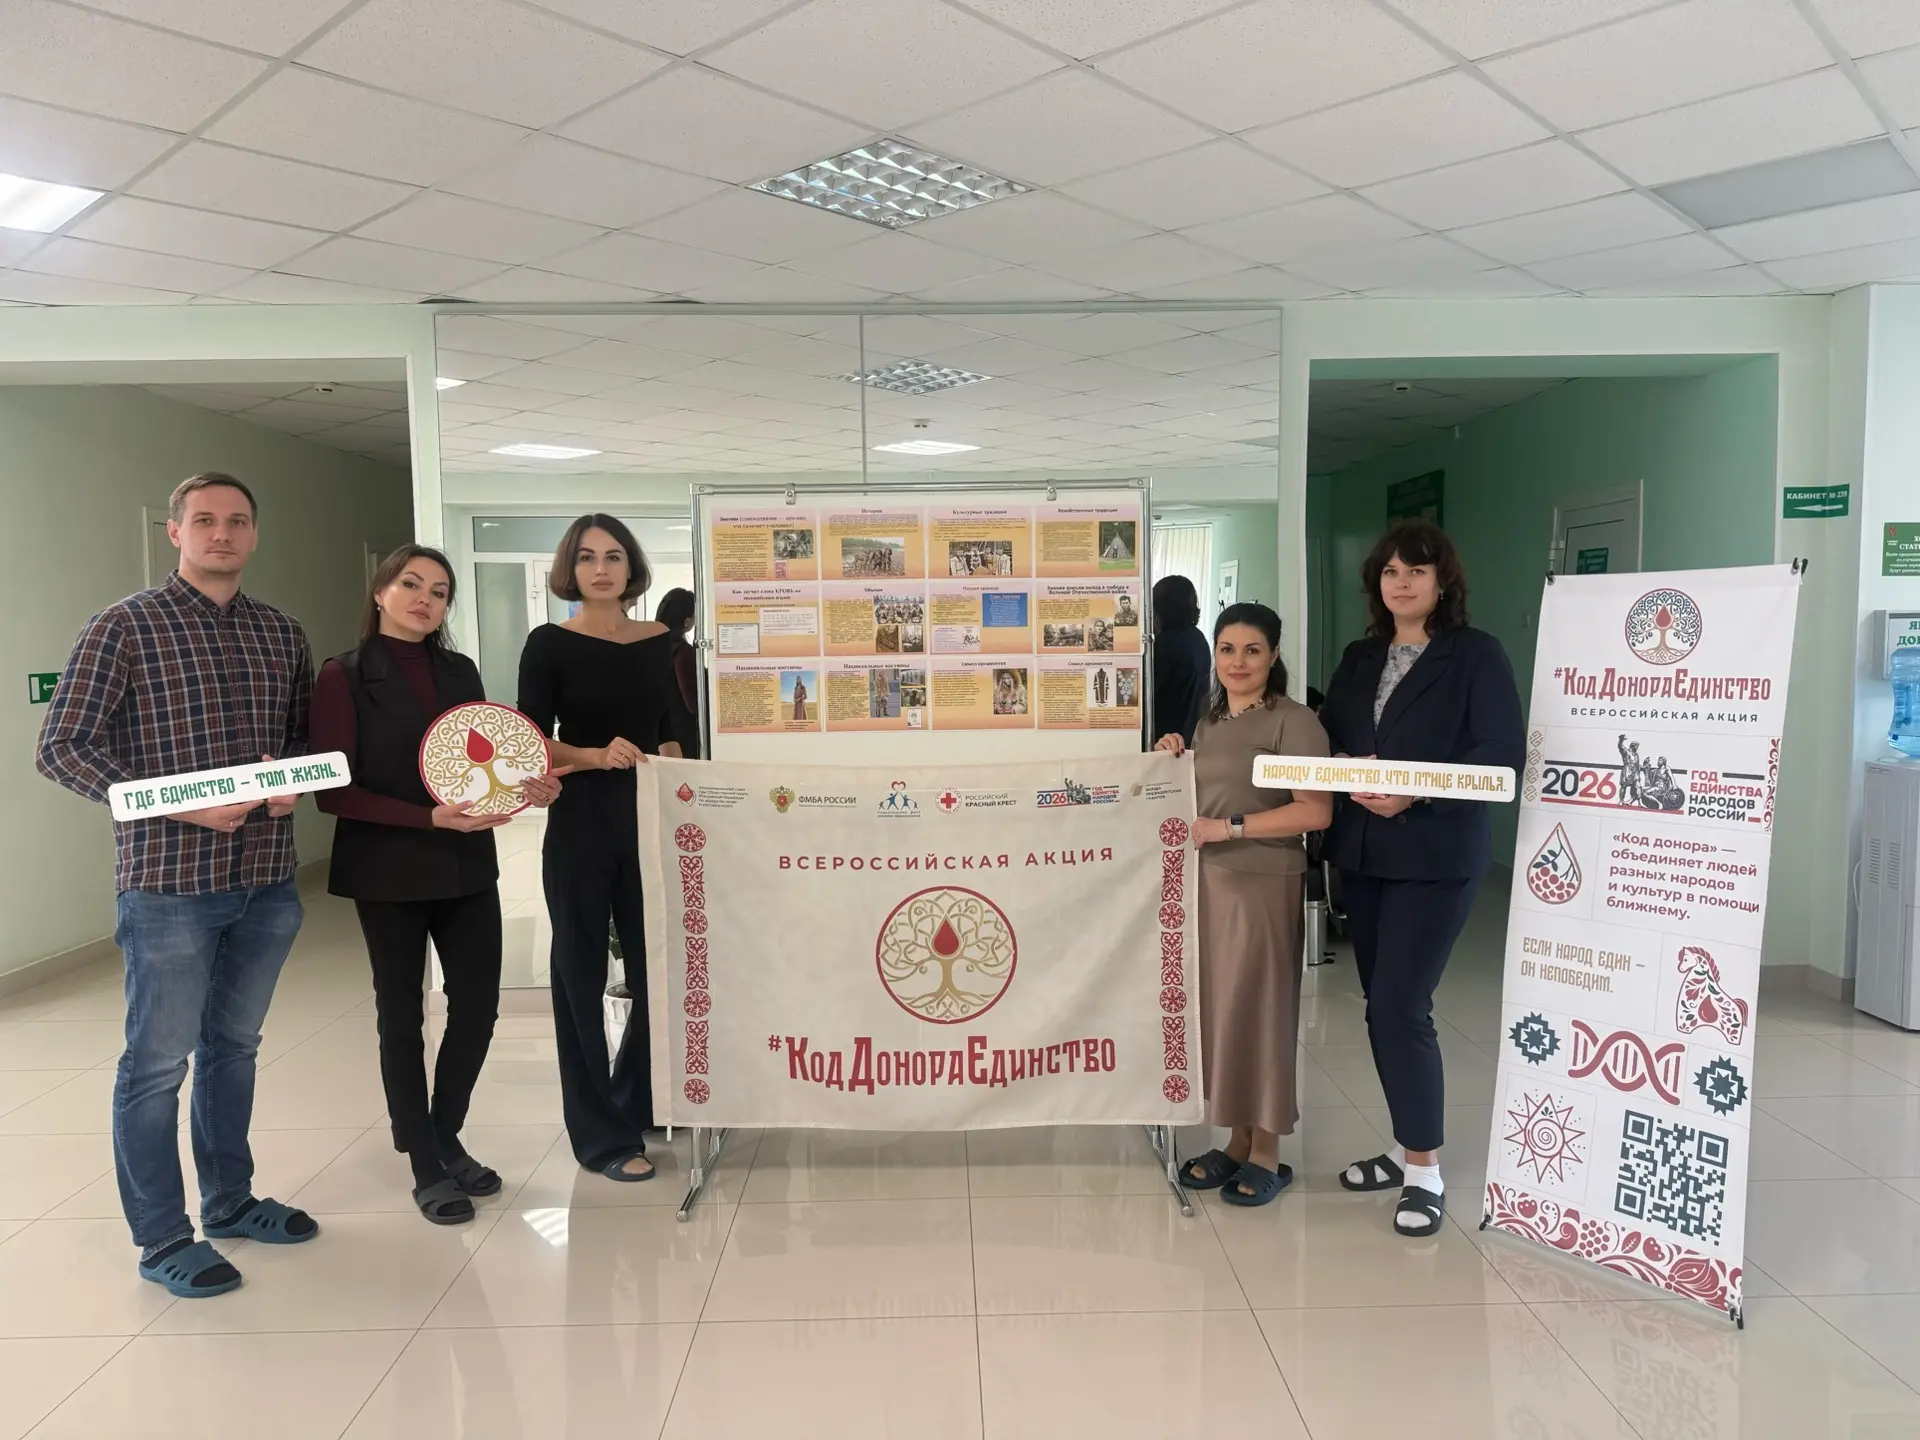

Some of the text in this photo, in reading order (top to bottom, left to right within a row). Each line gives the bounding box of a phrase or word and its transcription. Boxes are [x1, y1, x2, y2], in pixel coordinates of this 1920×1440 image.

[1786, 492, 1828, 500] КАБИНЕТ
[1909, 620, 1920, 630] Я
[1571, 707, 1758, 723] ВСЕРОССИЙСКАЯ АКЦИЯ
[123, 790, 155, 810] ГДЕ
[159, 777, 236, 805] ЕДИНСТВО
[255, 770, 287, 789] ТАМ
[290, 763, 341, 784] ЖИЗНЬ.
[1263, 764, 1310, 783] НАРОДУ
[1414, 772, 1453, 790] ПТИЦЕ
[1457, 776, 1507, 792] КРЫЛЬЯ.
[1542, 767, 1617, 800] 2026
[1691, 770, 1718, 784] ГОД
[798, 796, 856, 804] ФМБА РОССИИ
[1037, 793, 1066, 805] 2026
[1689, 794, 1755, 810] НАРОДОВ
[1690, 783, 1763, 798] ЕДИНСТВА
[1688, 806, 1746, 822] РОССИИ
[1613, 832, 1649, 847] «Код
[1653, 838, 1717, 854] донора»
[779, 846, 1113, 871] ВСЕРОССИЙСКАЯ АКЦИЯ
[1611, 848, 1758, 876] объединяет людей
[1610, 866, 1735, 891] разных народов
[1606, 896, 1691, 920] ближнему.
[1608, 882, 1760, 913] и культур в помощи
[1523, 936, 1552, 957] ЕСЛИ
[1556, 942, 1593, 968] НАРОД
[1598, 951, 1631, 972] ЕДИН
[1521, 960, 1614, 993] ОН НЕПОБЕДИМ.
